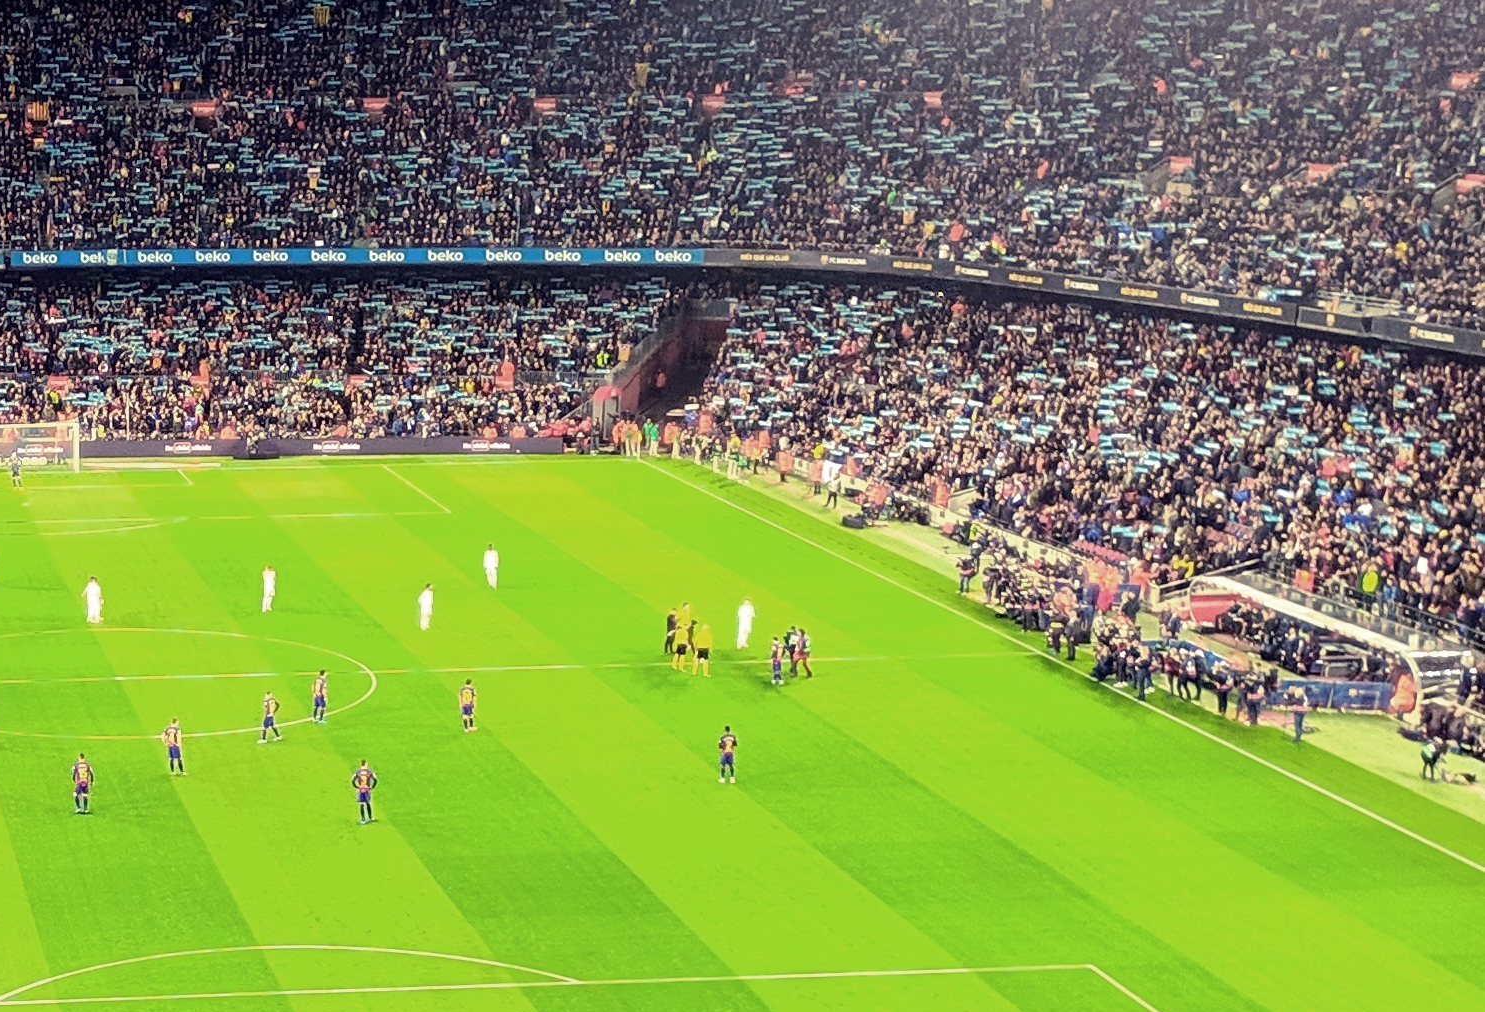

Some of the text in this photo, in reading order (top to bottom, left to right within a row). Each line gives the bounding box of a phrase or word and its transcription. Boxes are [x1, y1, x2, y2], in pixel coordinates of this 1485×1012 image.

[23, 252, 57, 264] beko
[80, 252, 106, 264] bek
[137, 251, 173, 263] beko
[195, 250, 230, 262] beko
[253, 250, 288, 262] beko
[311, 250, 346, 262] beko
[369, 250, 405, 262] beko
[428, 250, 463, 262] beko
[485, 250, 522, 262] beko
[544, 250, 581, 262] beko
[604, 250, 641, 262] beko
[655, 250, 692, 262] beko
